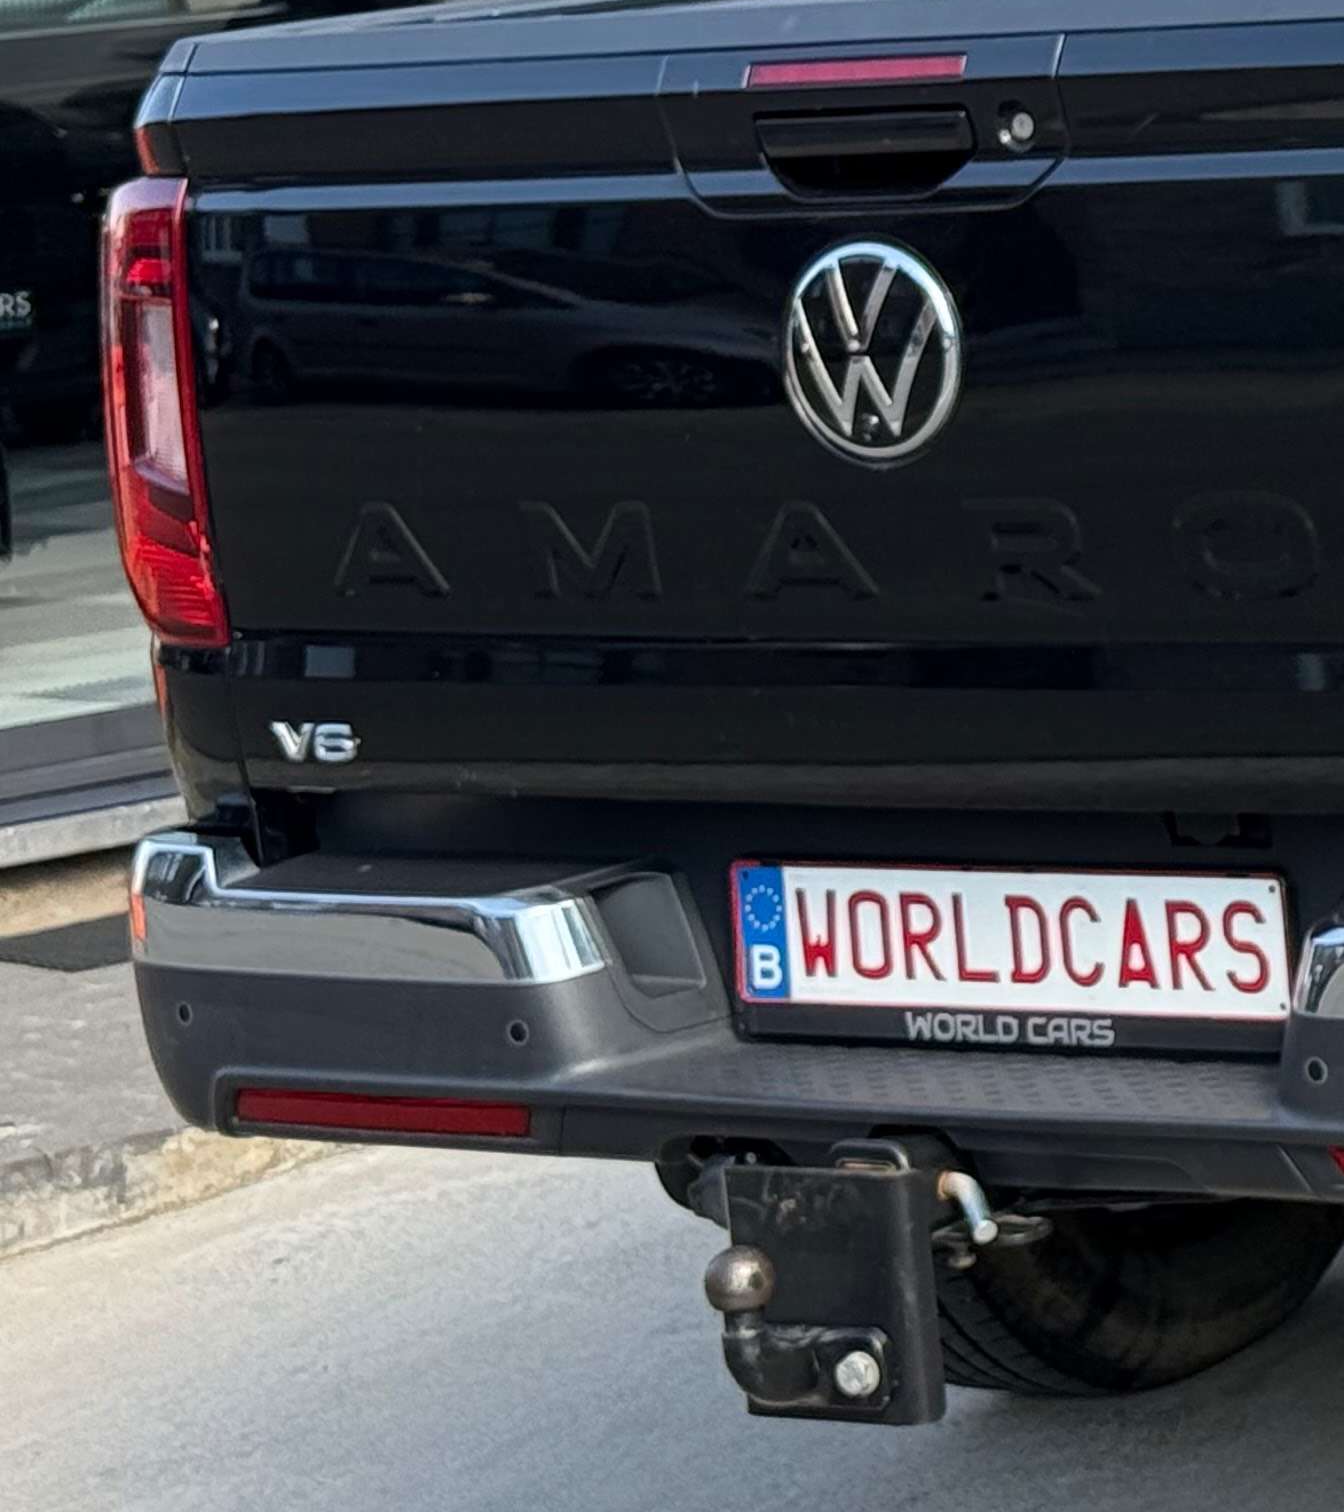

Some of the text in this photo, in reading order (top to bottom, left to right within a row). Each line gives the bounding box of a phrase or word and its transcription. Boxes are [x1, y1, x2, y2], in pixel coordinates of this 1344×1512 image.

[270, 721, 361, 762] V6
[796, 888, 1270, 994] WORLDCARS
[751, 943, 782, 989] B
[905, 1011, 1116, 1048] WORLD CARS
